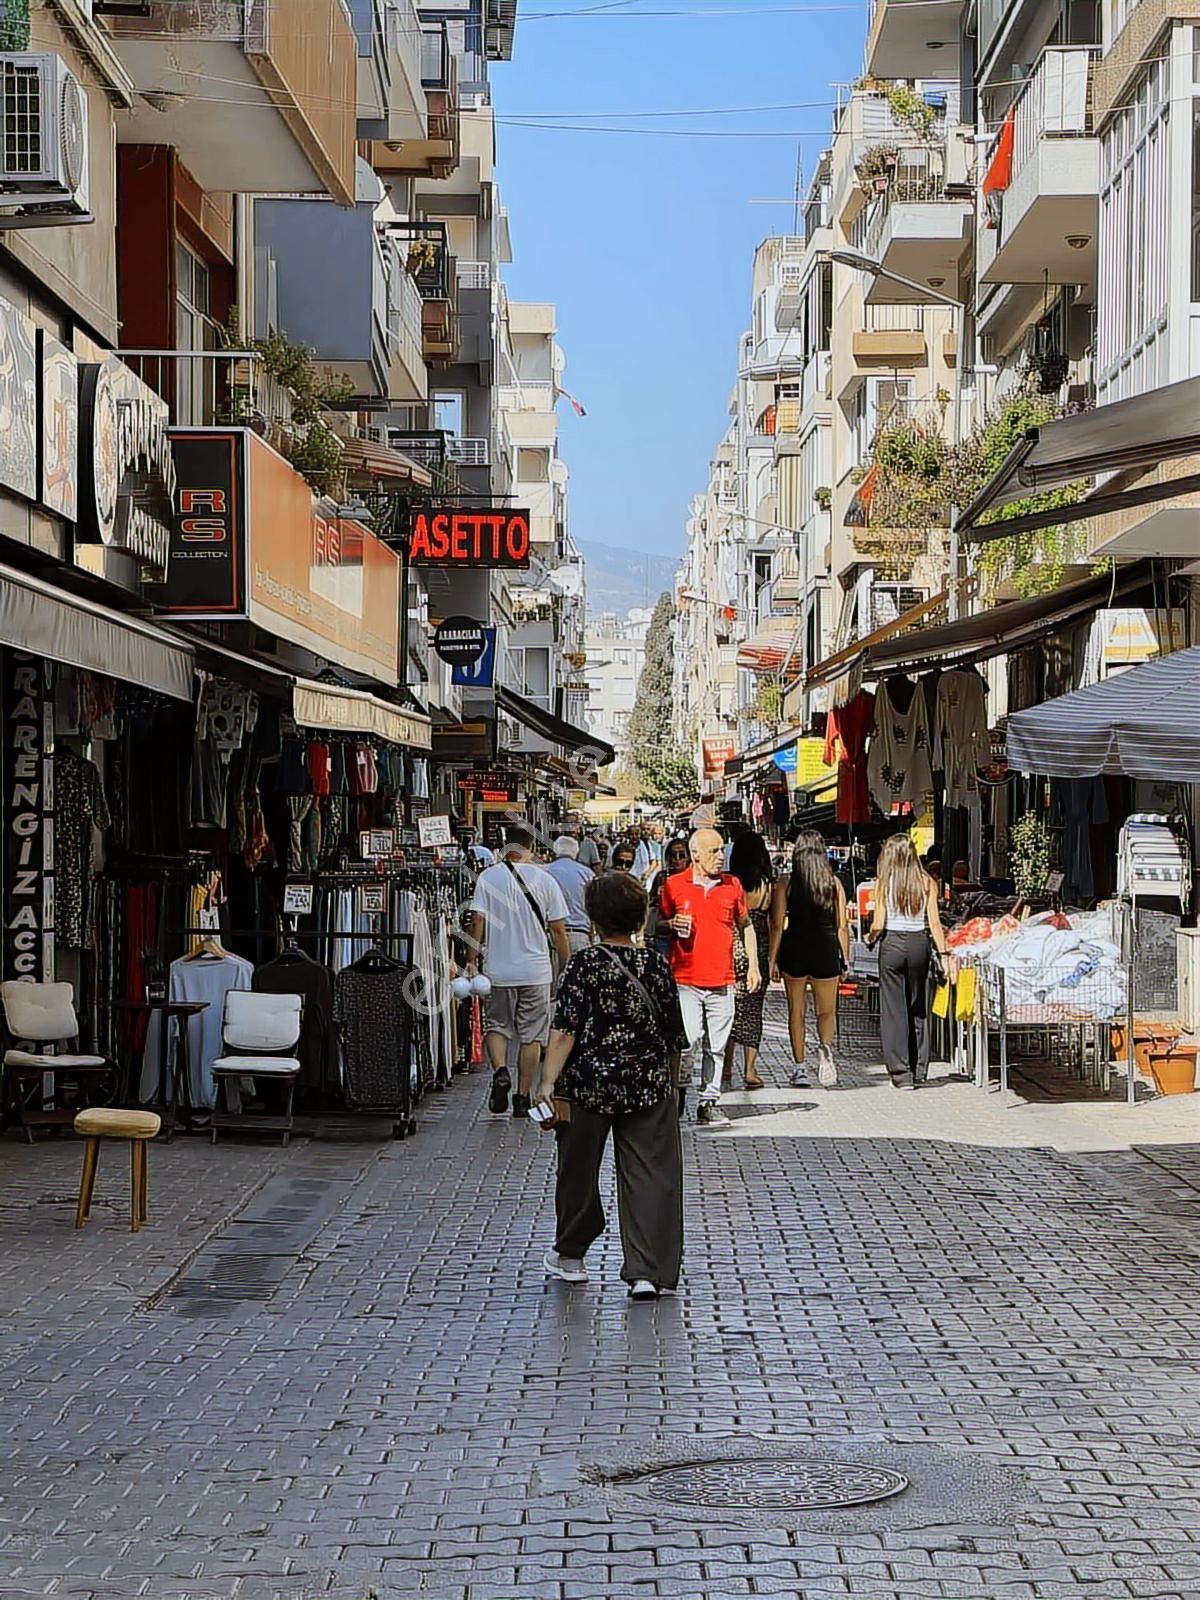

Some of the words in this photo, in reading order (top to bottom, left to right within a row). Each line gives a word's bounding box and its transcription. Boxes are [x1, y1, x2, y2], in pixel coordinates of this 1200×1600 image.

[171, 551, 229, 559] COLLECTION
[409, 513, 529, 560] ASETTO
[9, 652, 40, 895] RARENGİZ
